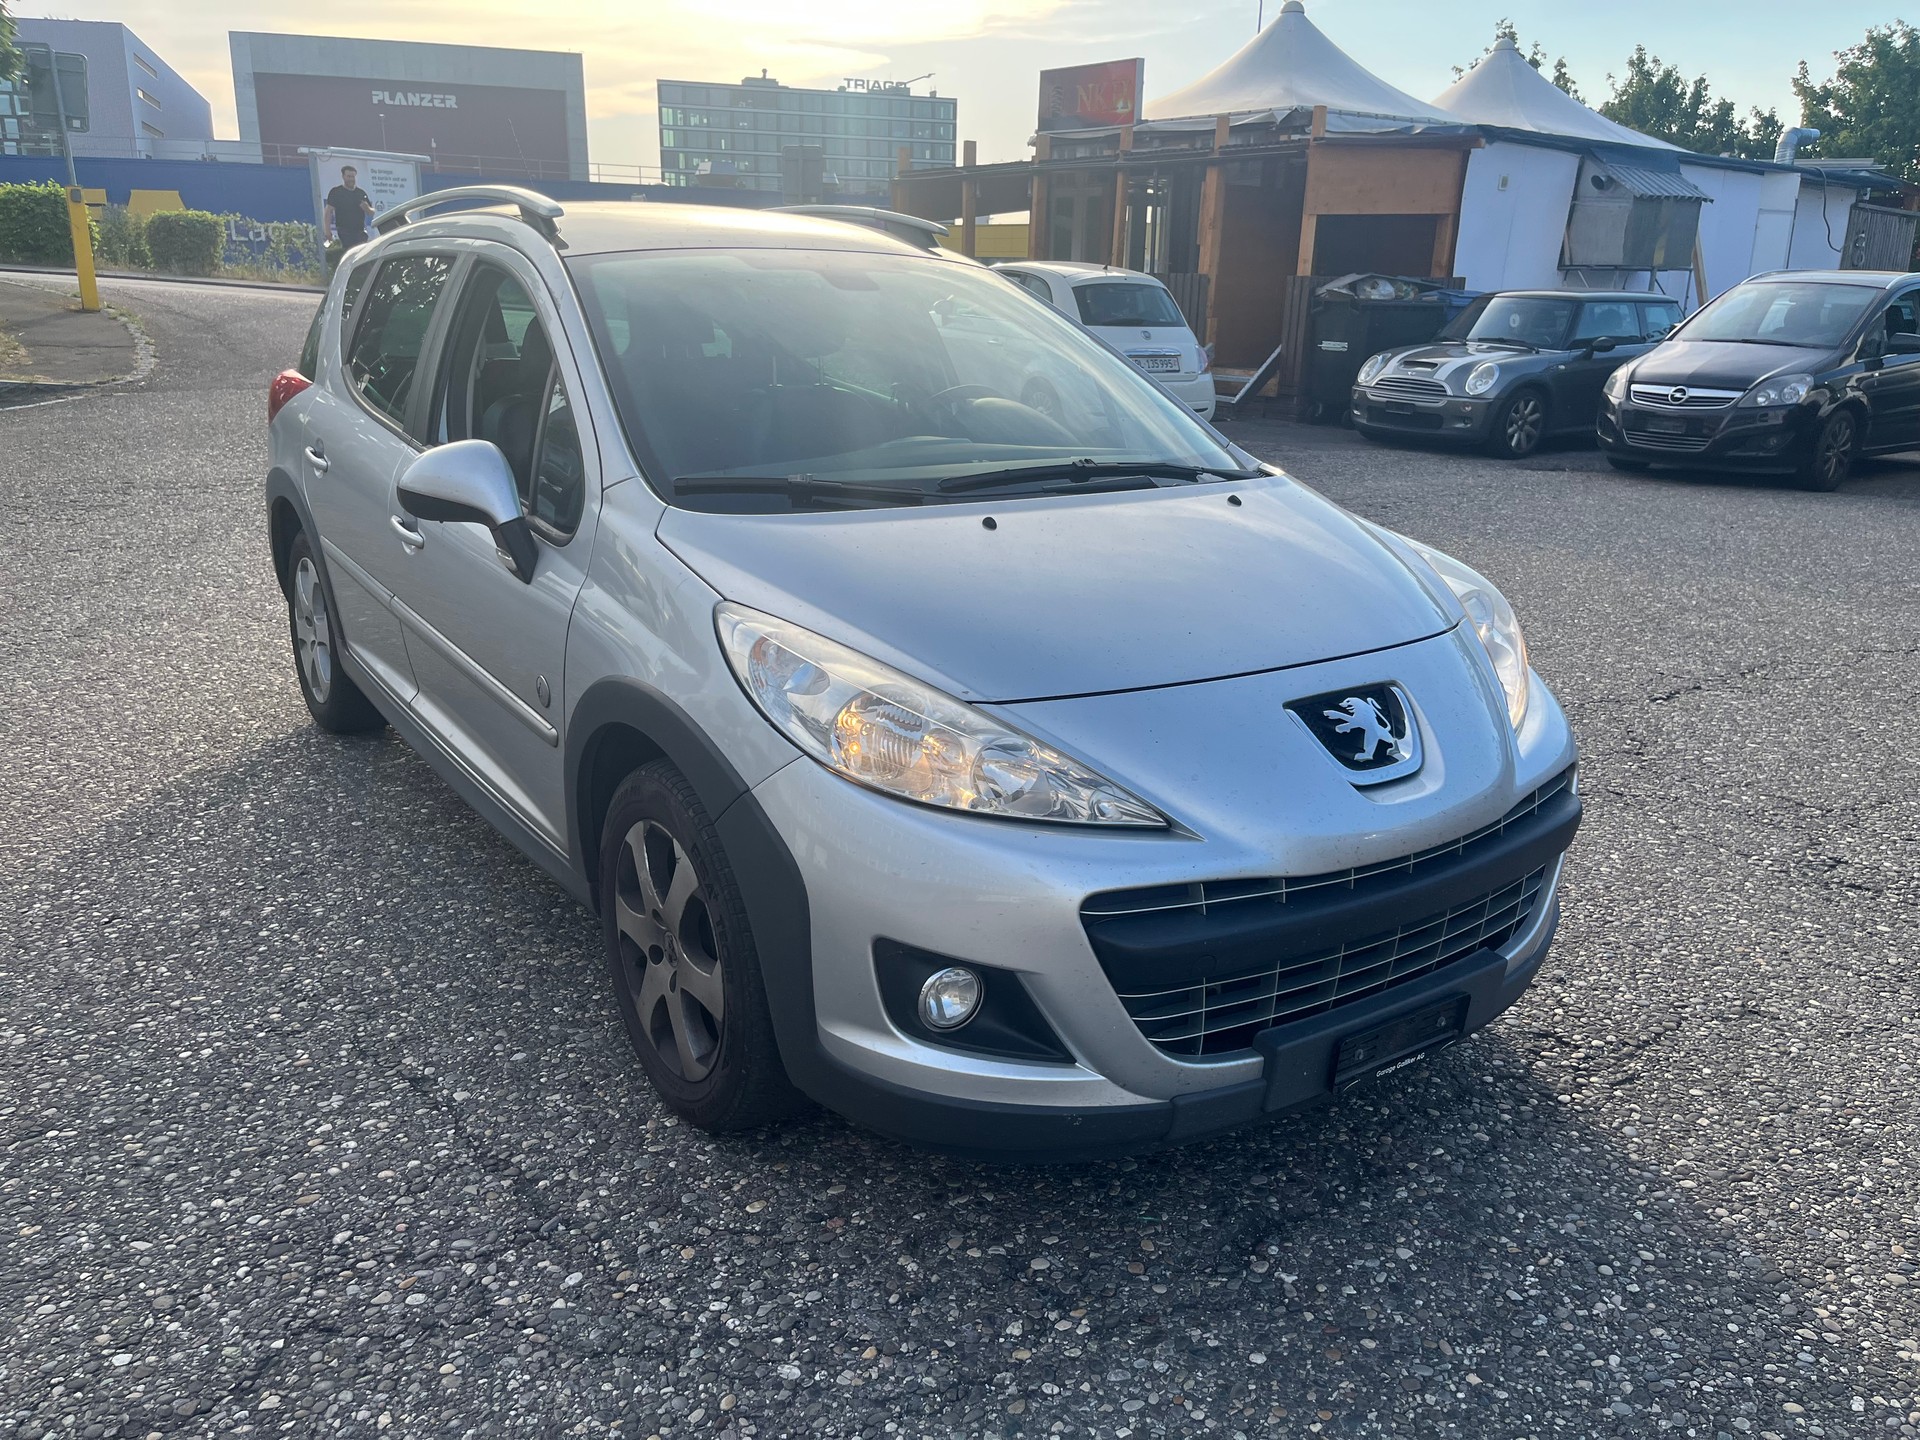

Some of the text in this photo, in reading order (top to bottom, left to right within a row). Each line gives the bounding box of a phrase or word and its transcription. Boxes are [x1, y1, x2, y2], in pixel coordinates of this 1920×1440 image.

[372, 90, 458, 109] PLANZER
[1376, 1052, 1425, 1077] Garage Galliker AG
